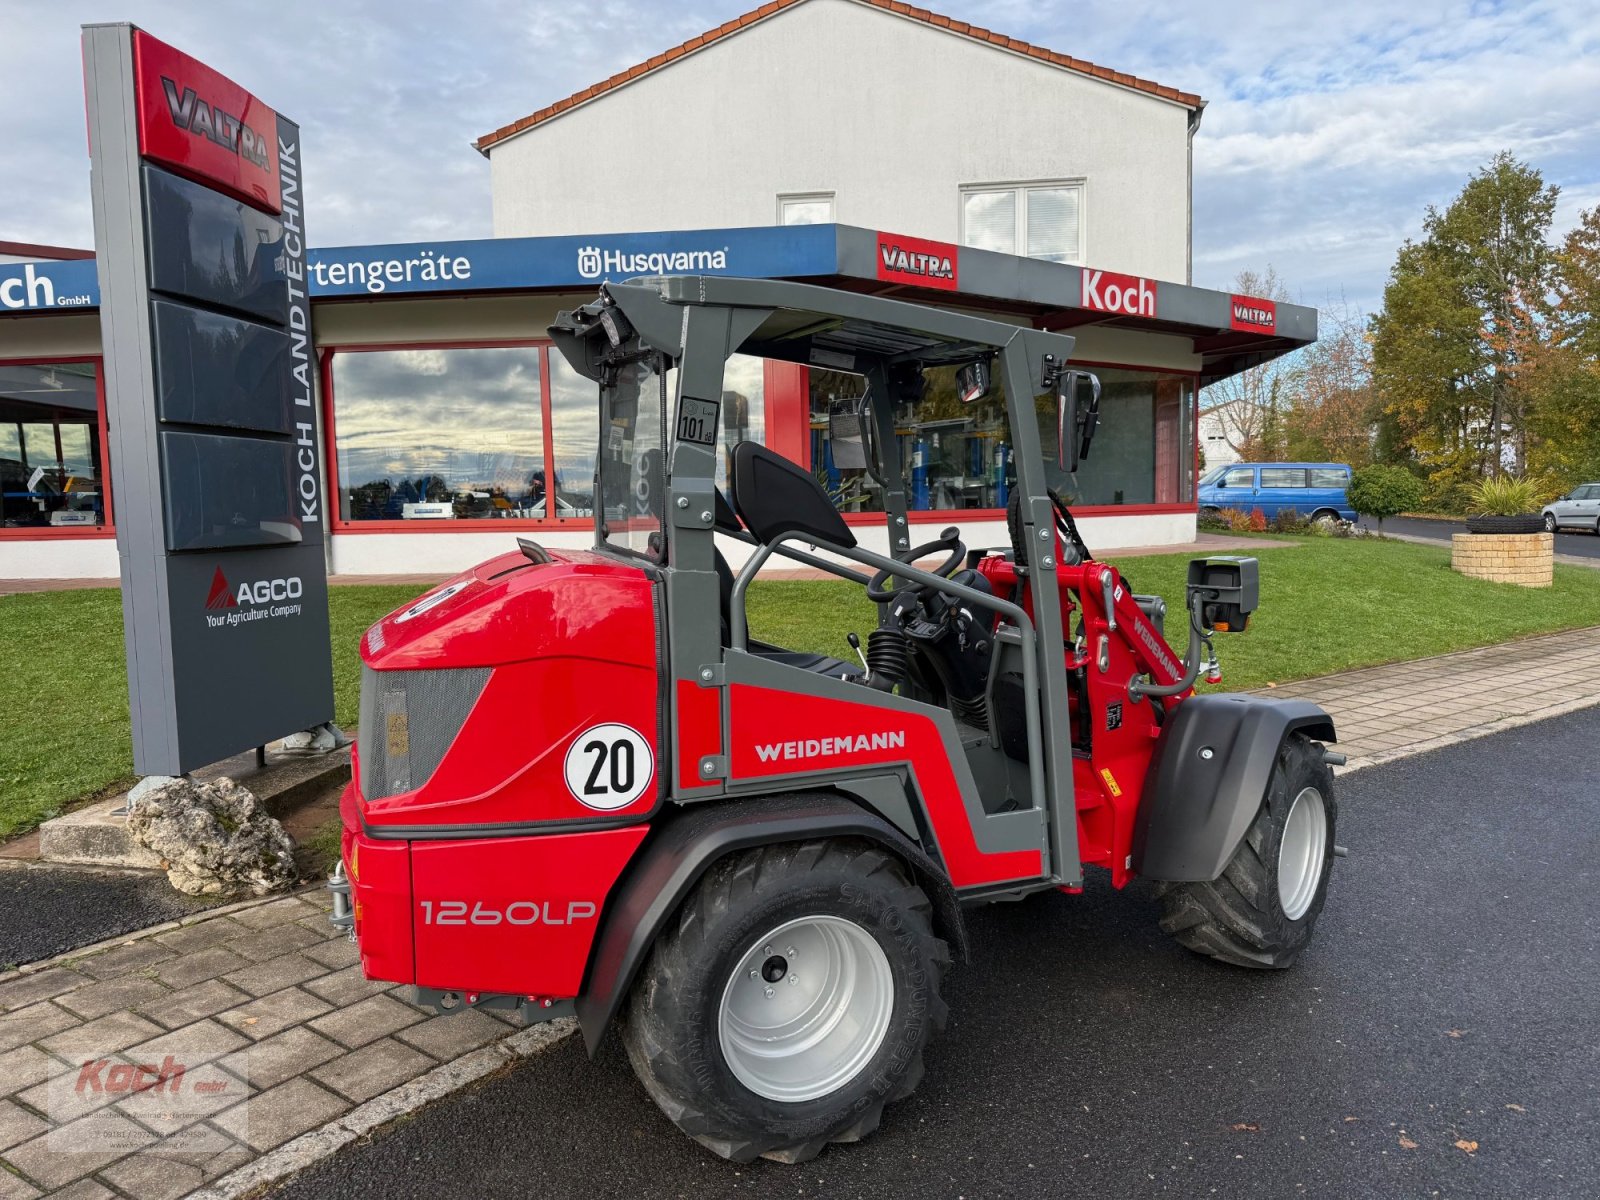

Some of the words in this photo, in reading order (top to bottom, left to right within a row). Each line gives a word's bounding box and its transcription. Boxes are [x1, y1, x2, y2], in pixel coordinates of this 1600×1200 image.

[160, 75, 271, 173] VALTRA
[278, 136, 311, 407] LANDTECHNIK
[604, 249, 726, 275] Husqvarna
[880, 244, 954, 280] VALTRA
[57, 295, 91, 305] GmbH
[1082, 268, 1154, 315] Koch
[1233, 302, 1274, 326] VALTRA
[682, 416, 704, 441] 101
[296, 422, 318, 522] KOCH
[237, 577, 303, 605] AGCO
[206, 615, 225, 627] Your
[226, 608, 269, 627] Agriculture
[270, 604, 302, 618] Company
[1134, 616, 1180, 681] WEIDEMANN
[754, 731, 905, 762] WEIDEMANN
[583, 739, 635, 795] 20
[420, 901, 596, 925] 1260LP
